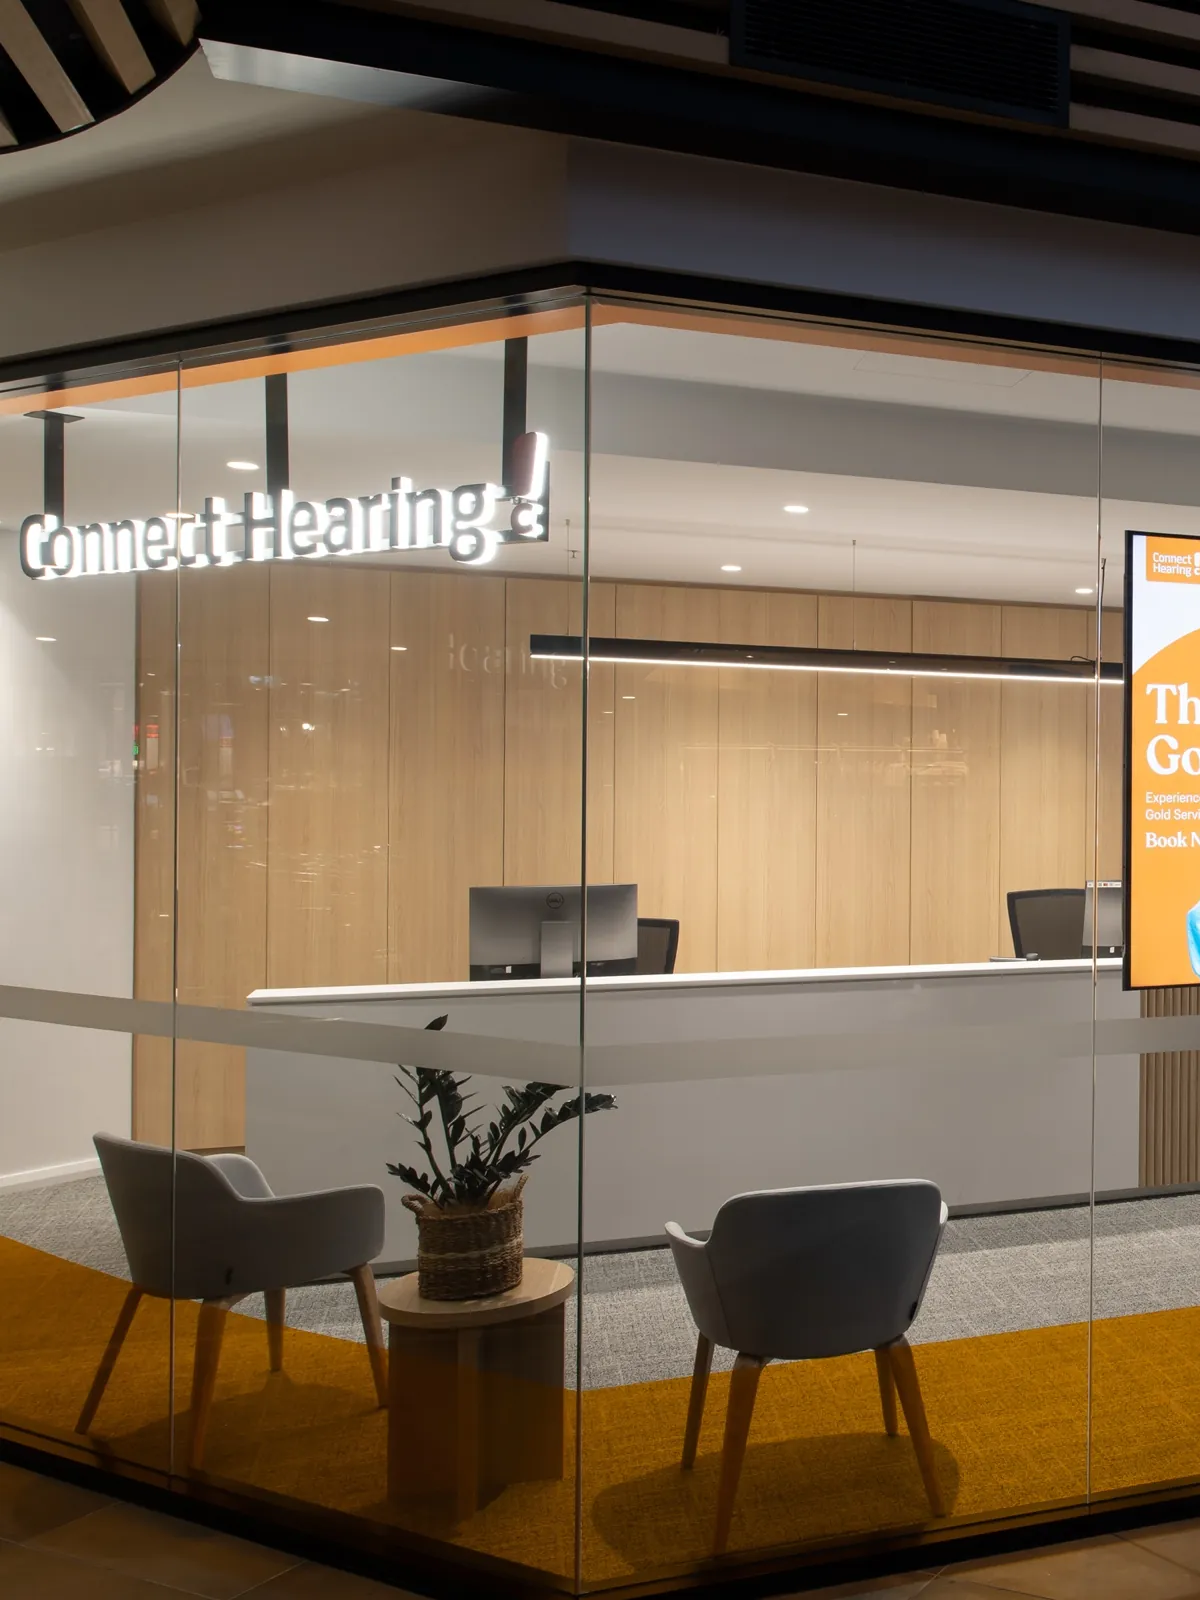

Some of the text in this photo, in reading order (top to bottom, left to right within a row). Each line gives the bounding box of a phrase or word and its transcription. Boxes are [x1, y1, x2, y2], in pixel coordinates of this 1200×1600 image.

[20, 497, 234, 580] Connect
[1153, 552, 1192, 565] Connect
[1145, 809, 1171, 821] Gold
[1145, 831, 1188, 848] Book
